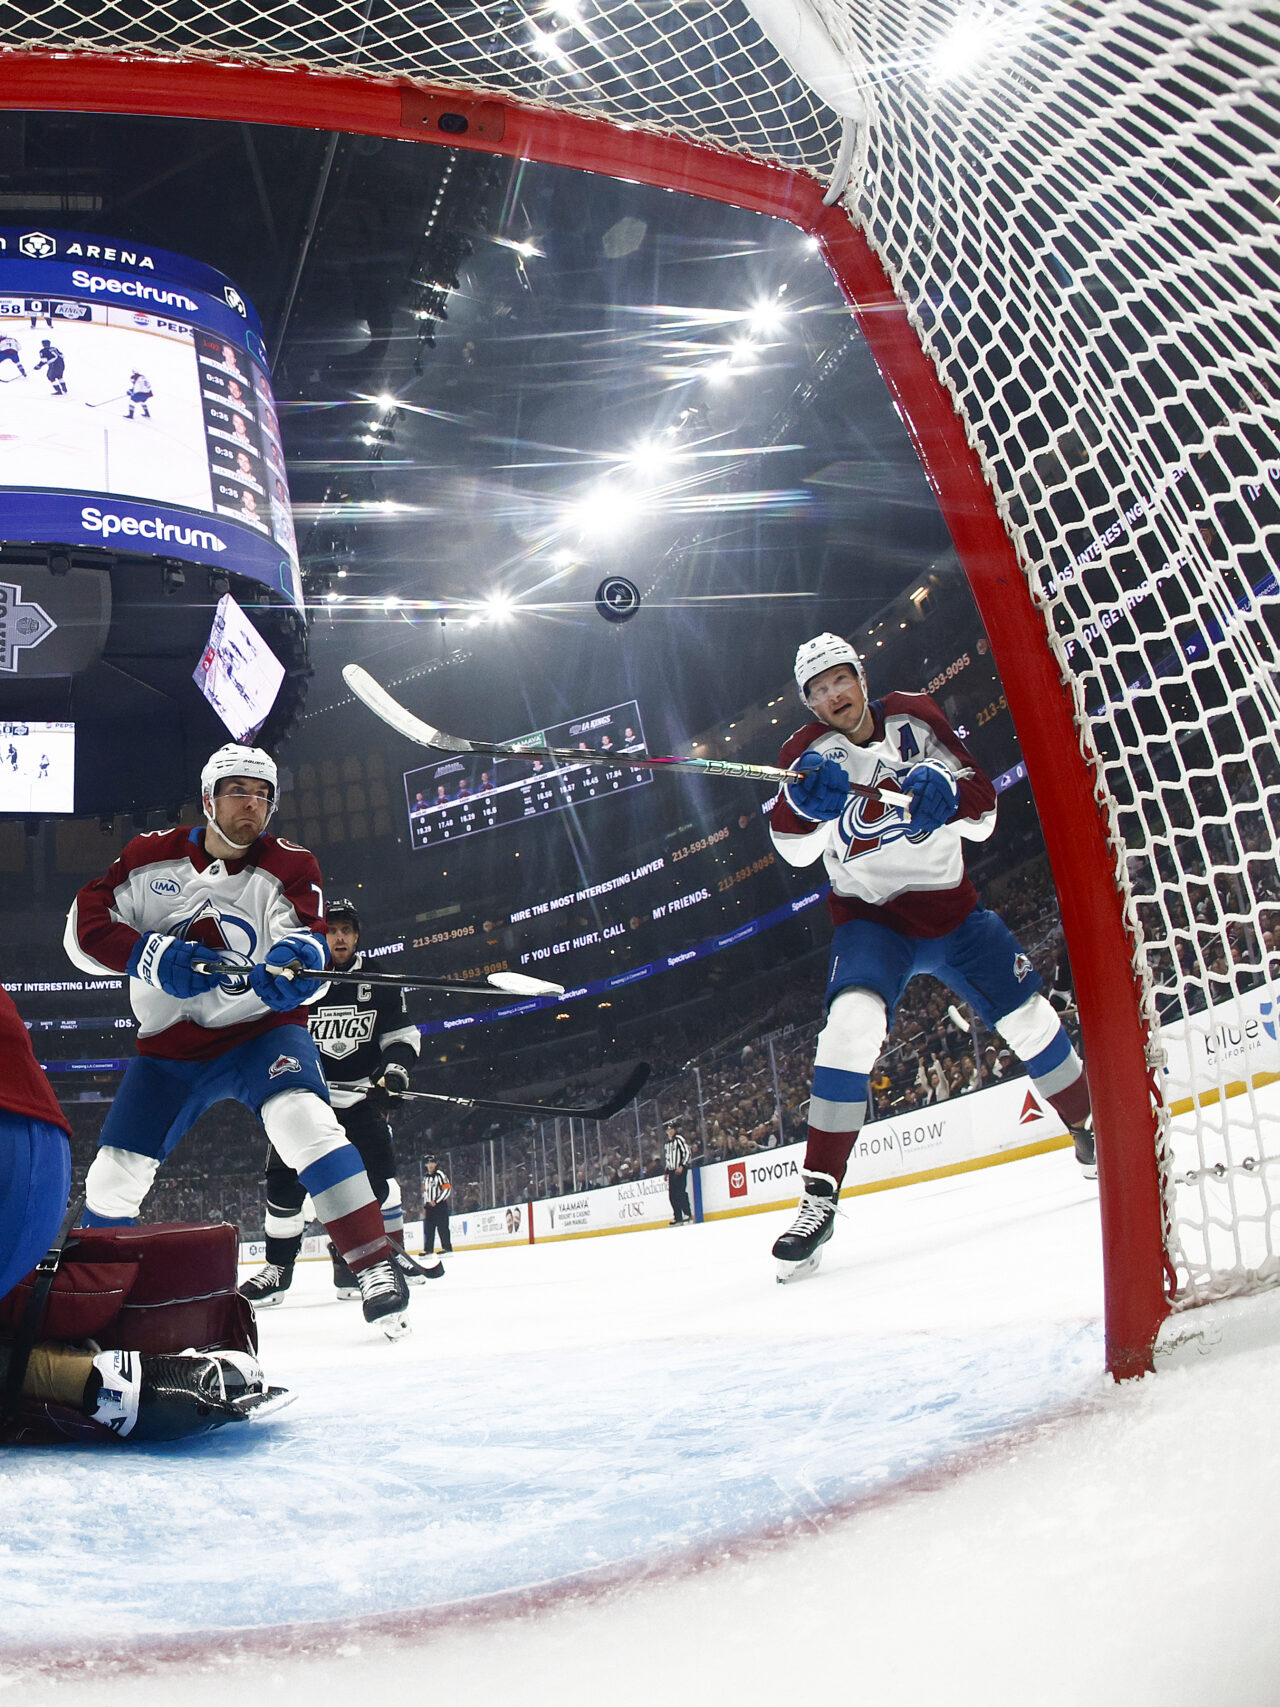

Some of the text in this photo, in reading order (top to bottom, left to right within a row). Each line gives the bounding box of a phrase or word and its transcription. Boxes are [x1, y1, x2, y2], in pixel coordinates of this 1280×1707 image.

[66, 243, 155, 270] ARENA
[72, 270, 194, 311] Spectrum
[31, 300, 43, 311] 0
[81, 507, 219, 551] Spectrum
[897, 722, 921, 762] A
[671, 826, 730, 863] 213-593-9095
[154, 881, 176, 894] IMA
[510, 857, 665, 924] HIRE THE MOST INTERESTING LAWYER
[310, 882, 324, 919] 7
[652, 887, 712, 920] MY FRIENDS.
[412, 925, 475, 948] 213-593-9095
[521, 922, 626, 965] IF YOU GET HURT, CALL
[368, 942, 404, 958] LAWYER
[667, 951, 693, 967] Spectrum
[24, 981, 83, 992] INTERESTING
[85, 980, 123, 989] LAWYER
[357, 983, 372, 1003] C
[310, 1016, 371, 1040] KINGS
[443, 1017, 471, 1029] Spectrum
[853, 1121, 943, 1159] IRON BOW
[750, 1160, 799, 1184] TOYOTA
[617, 1185, 635, 1201] Keck
[558, 1200, 589, 1212] YAAMAVA
[619, 1201, 645, 1220] of USC
